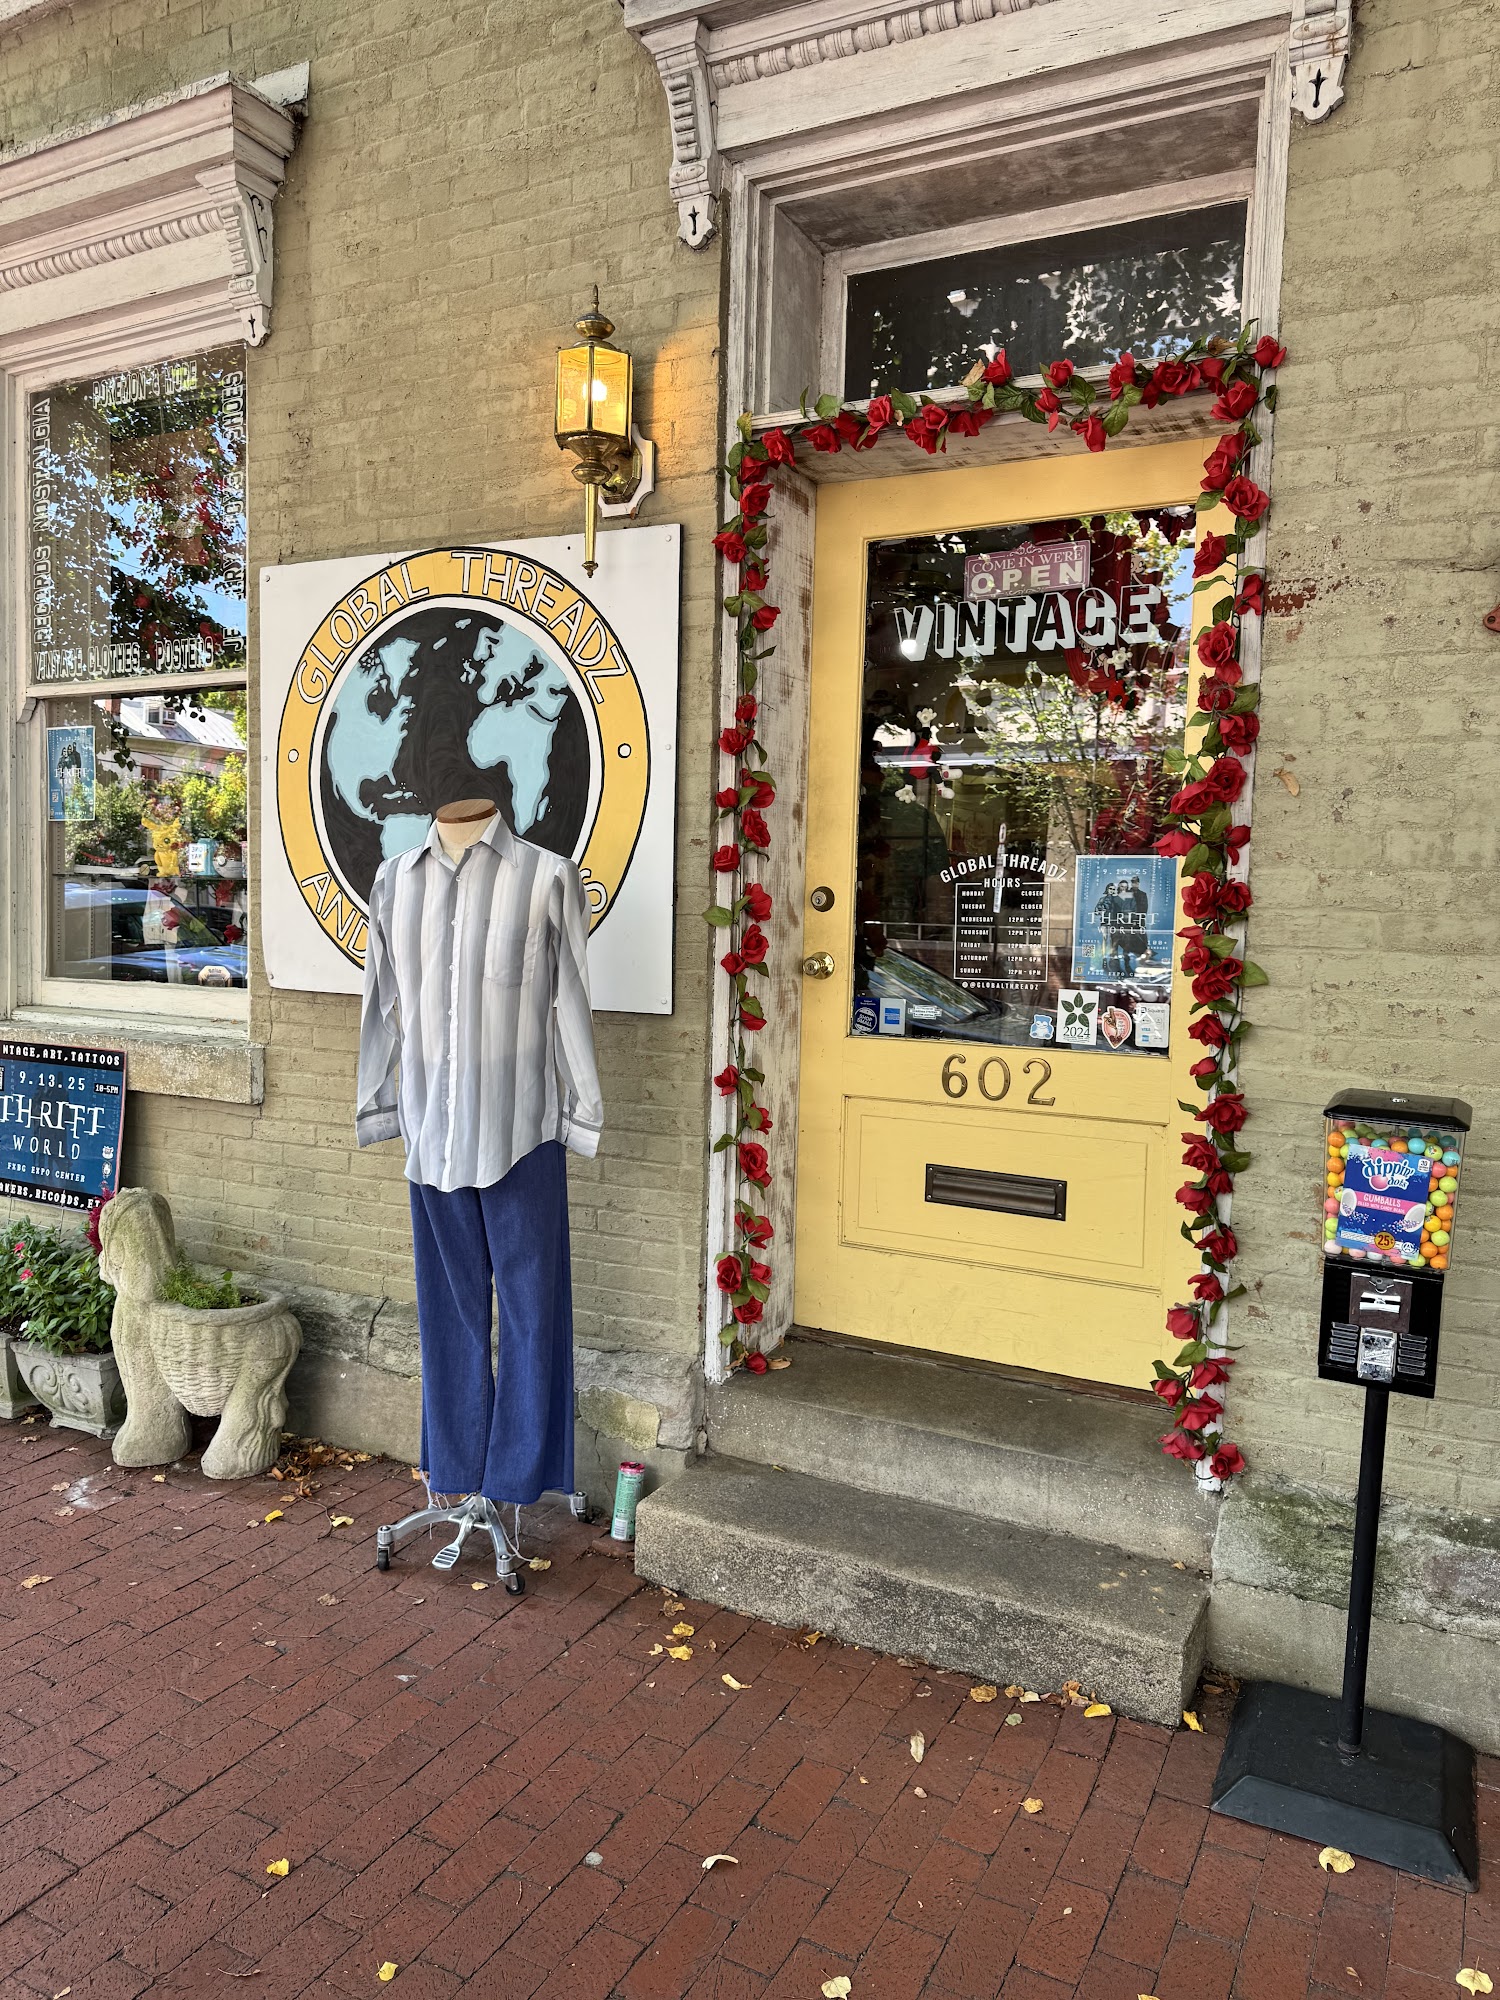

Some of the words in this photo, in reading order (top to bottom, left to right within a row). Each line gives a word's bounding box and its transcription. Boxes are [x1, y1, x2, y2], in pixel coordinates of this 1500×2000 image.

[222, 371, 243, 441] SHOES
[32, 397, 51, 531] NOSTALGIA
[972, 558, 1015, 573] COME
[1019, 556, 1034, 567] IN
[1040, 550, 1083, 565] WE'RE
[971, 561, 1083, 594] OPEN
[33, 545, 53, 644] RECORDS
[297, 564, 430, 704] GLOBAL
[451, 550, 628, 705] THREADZ
[894, 583, 1162, 661] VINTAGE
[87, 642, 141, 676] CLOTHES
[155, 636, 214, 671] POSTERS
[940, 854, 995, 883] GLOBAL
[1001, 853, 1068, 880] THREADZ
[984, 877, 1021, 888] HOURS
[1087, 911, 1160, 929] THRIFT
[1063, 1026, 1090, 1037] 2024
[20, 1071, 85, 1091] 9.13.25
[941, 1053, 1056, 1106] 602
[0, 1093, 106, 1139] THRIFT
[13, 1135, 80, 1160] WORLD
[7, 1162, 26, 1172] FXBG
[31, 1166, 50, 1177] EXPO
[55, 1171, 85, 1183] CENTER
[1388, 1177, 1407, 1188] dots
[1363, 1194, 1401, 1207] GUMBALLS
